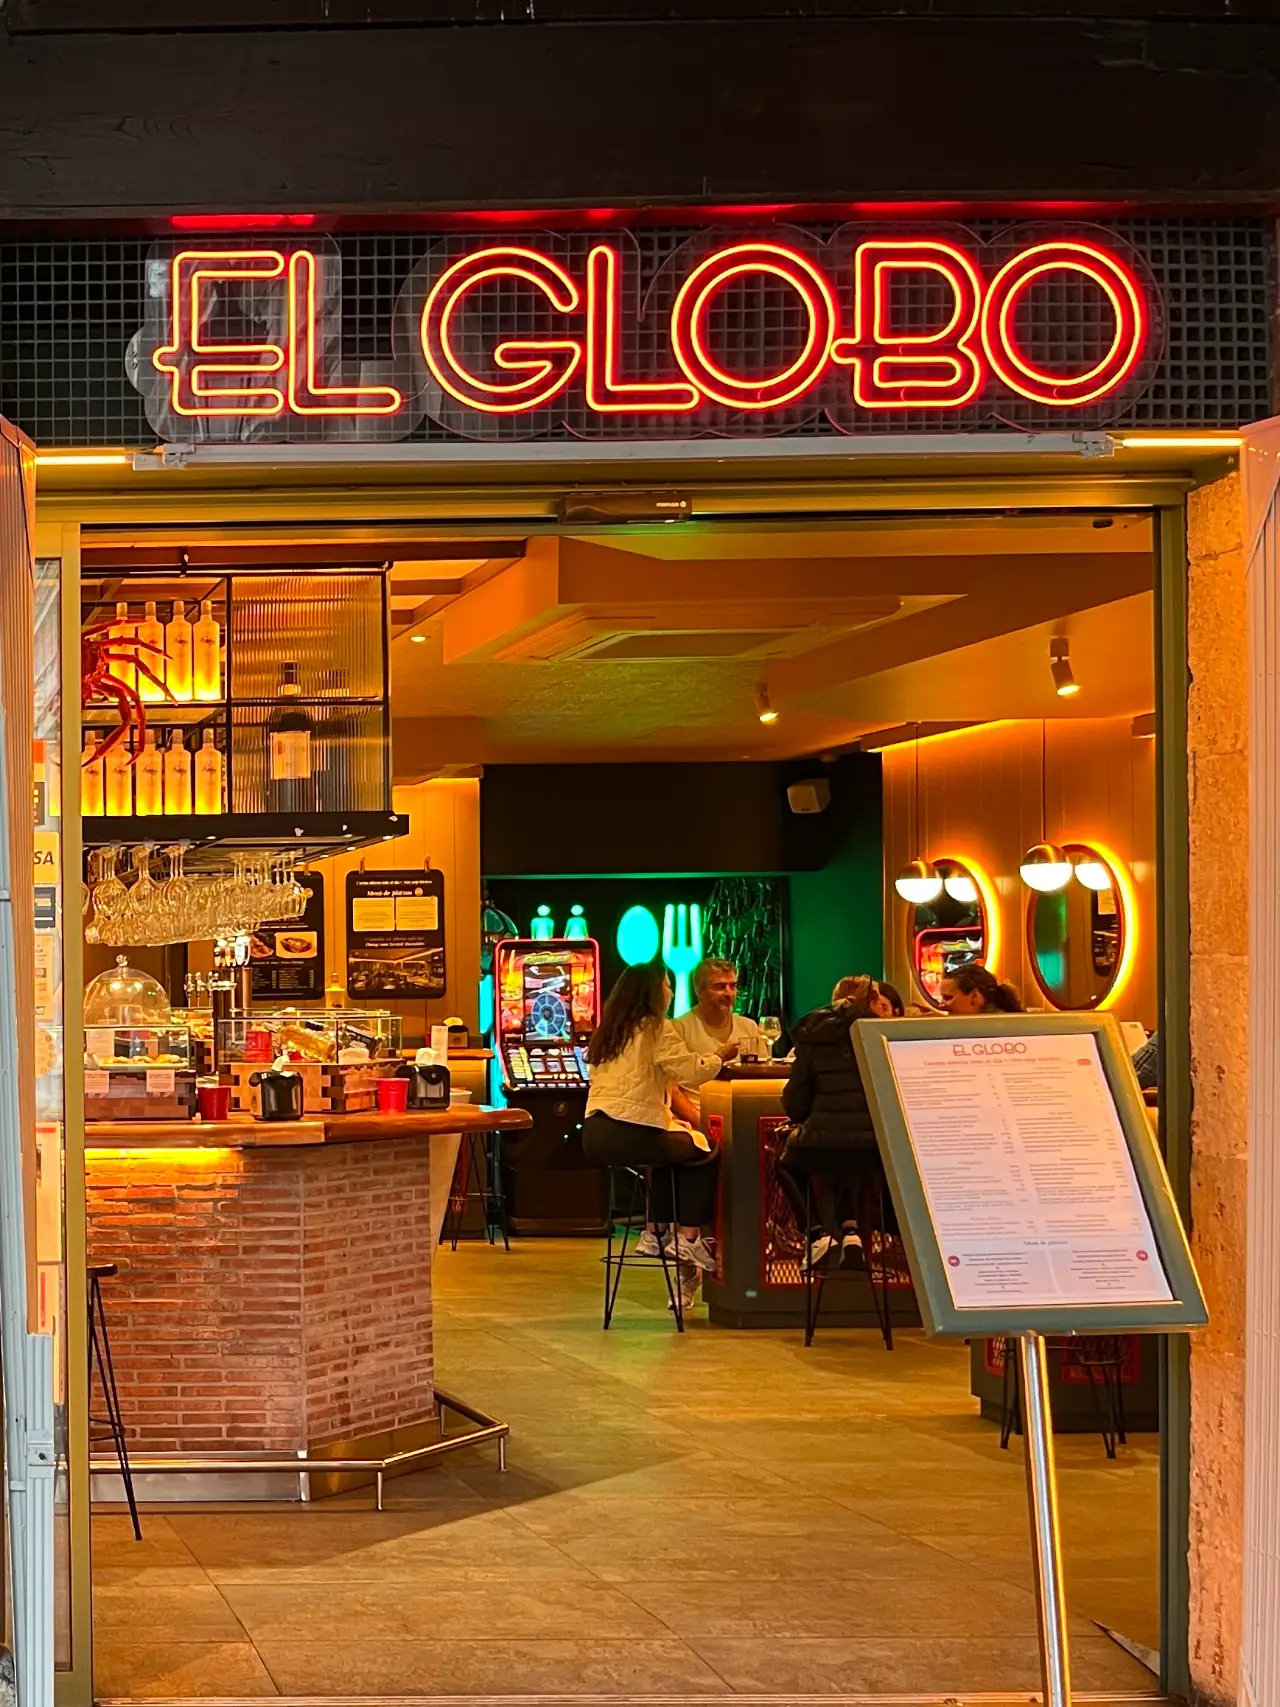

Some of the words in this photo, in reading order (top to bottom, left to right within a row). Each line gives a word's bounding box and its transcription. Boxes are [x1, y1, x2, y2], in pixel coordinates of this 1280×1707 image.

[153, 248, 402, 416] EL
[420, 240, 1143, 413] GLOBO
[33, 850, 54, 865] SA
[953, 1044, 971, 1056] EL
[972, 1042, 1027, 1055] GLOBO
